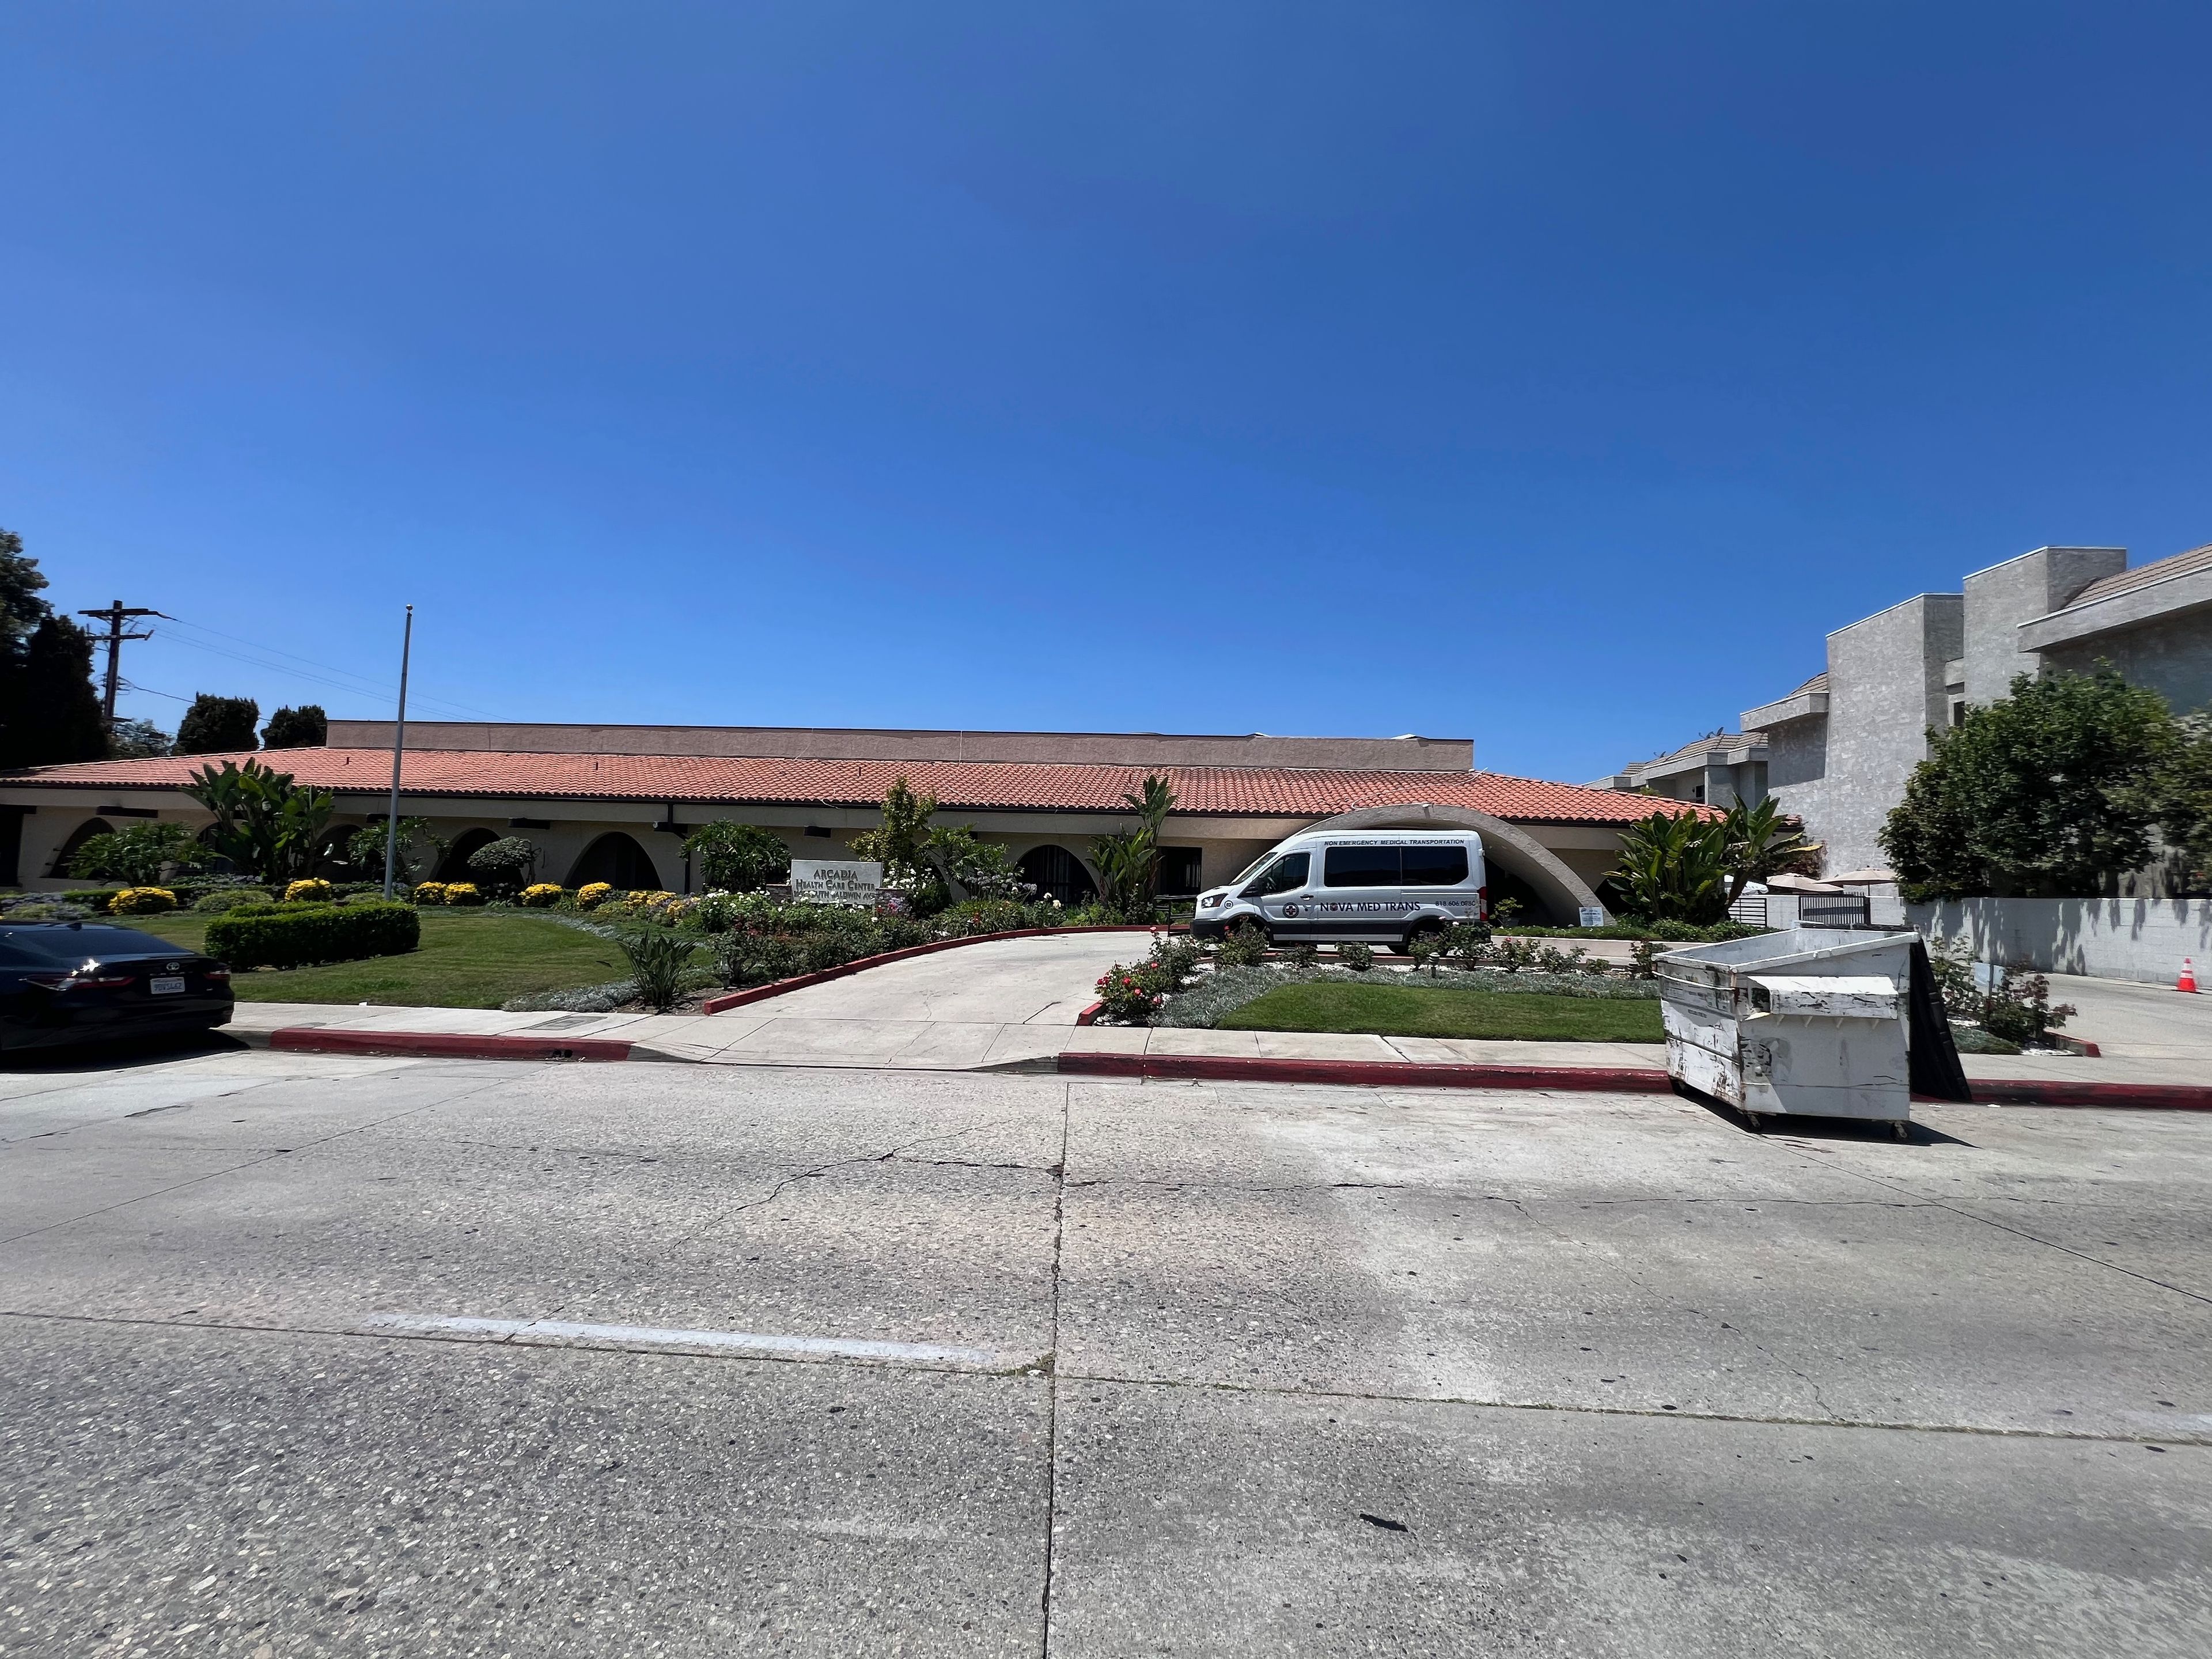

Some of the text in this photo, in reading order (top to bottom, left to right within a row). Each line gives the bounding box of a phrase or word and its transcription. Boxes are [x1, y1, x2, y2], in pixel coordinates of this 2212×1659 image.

[813, 869, 858, 881] ARCADIA
[1320, 901, 1421, 912] NOVA MED TRANS
